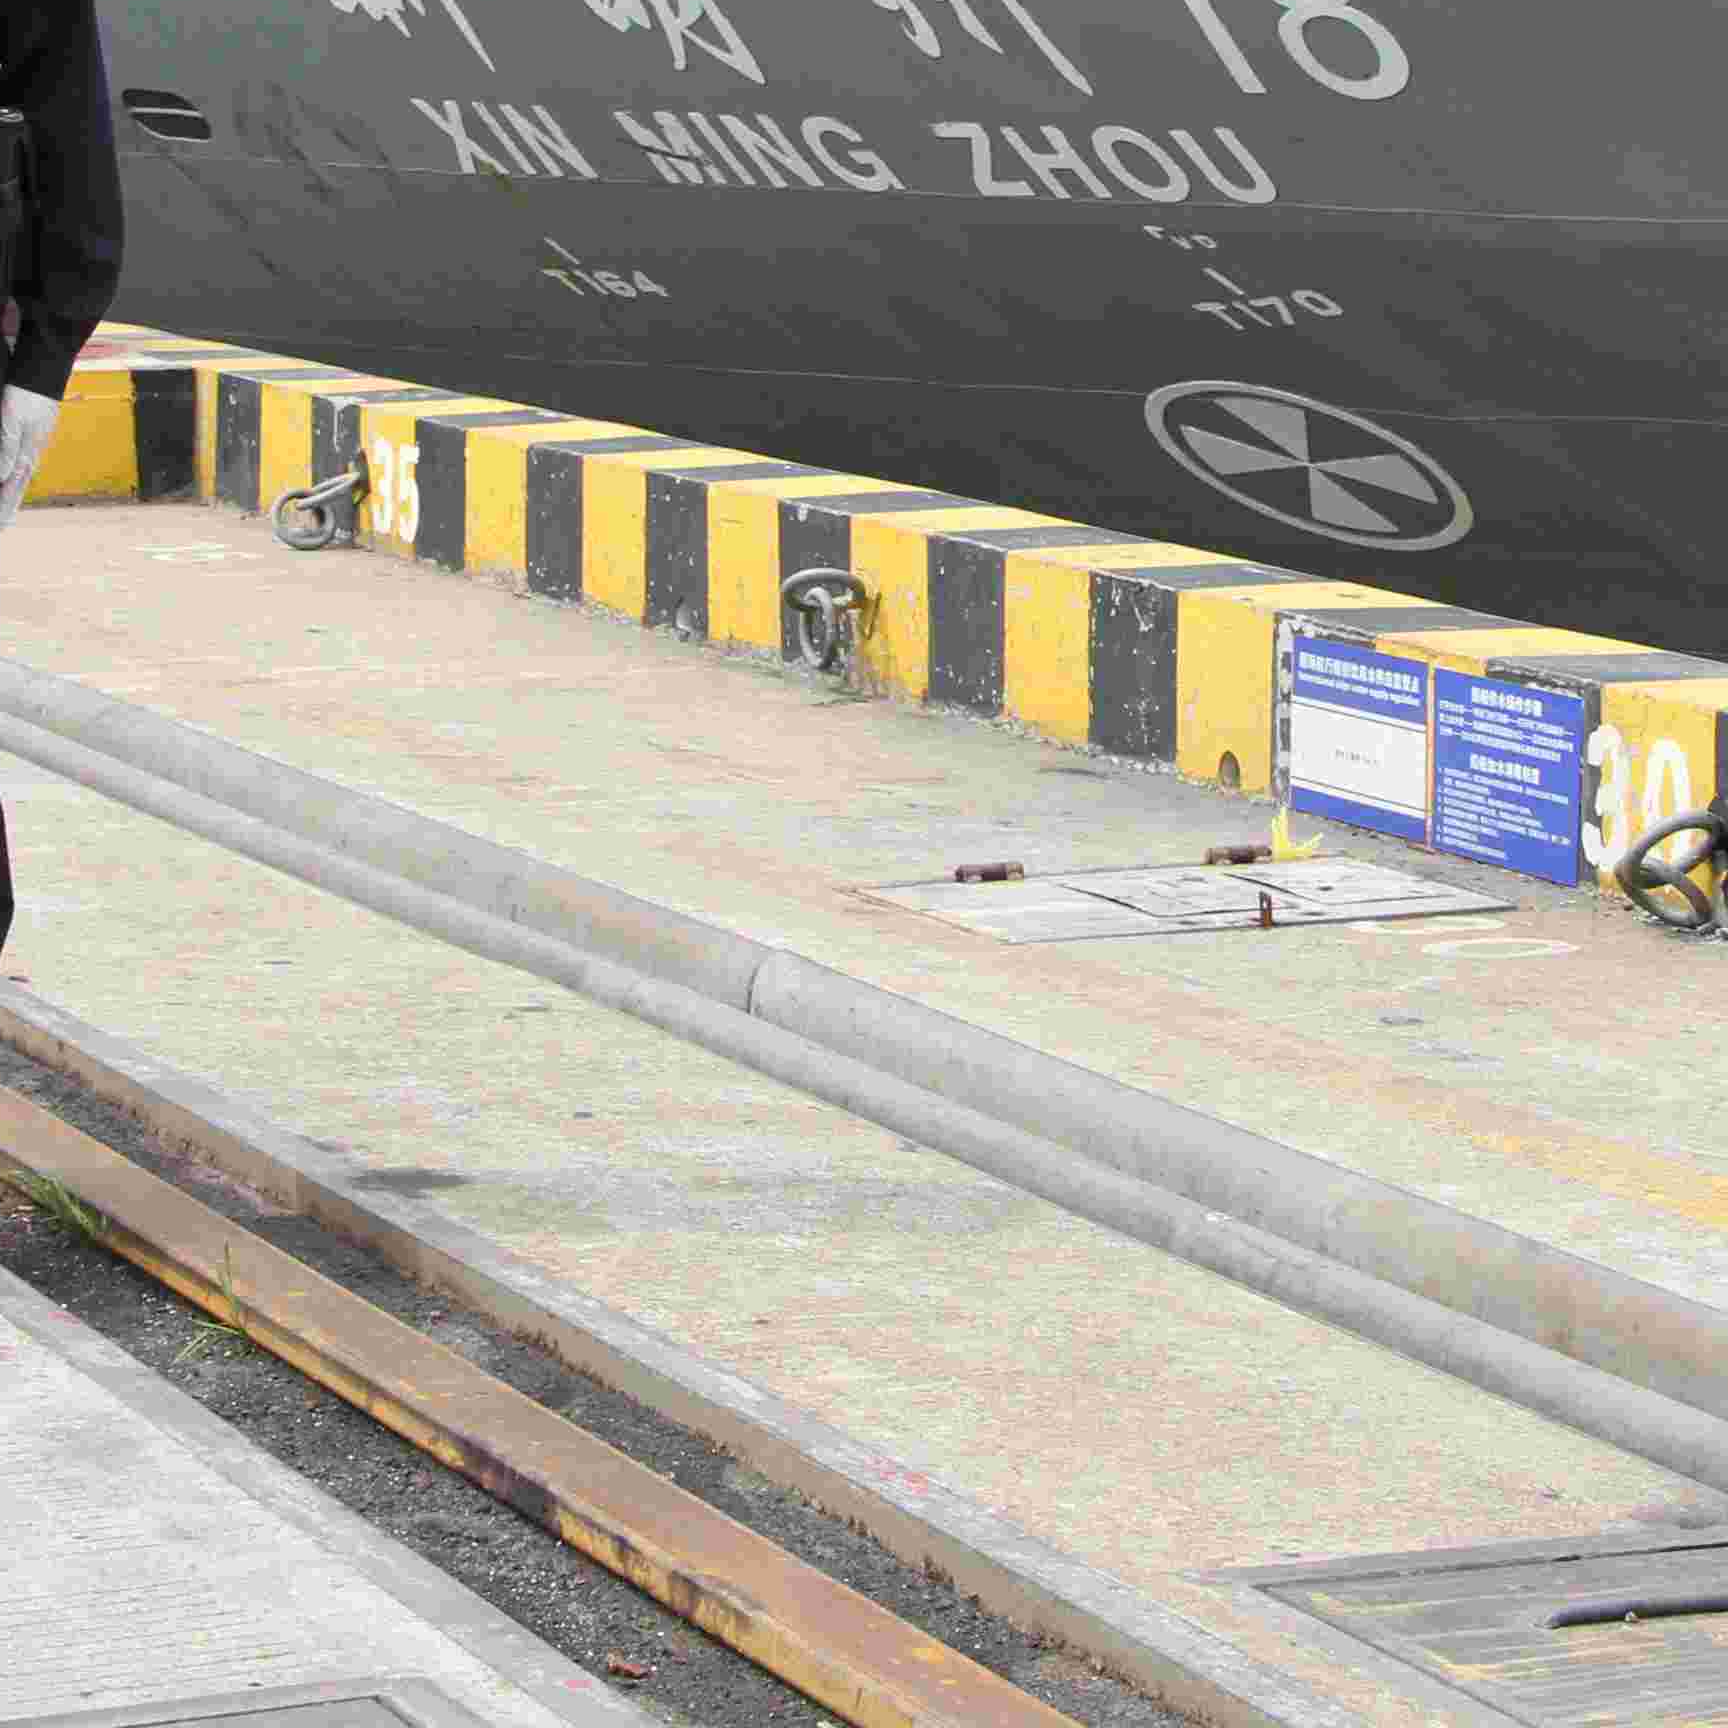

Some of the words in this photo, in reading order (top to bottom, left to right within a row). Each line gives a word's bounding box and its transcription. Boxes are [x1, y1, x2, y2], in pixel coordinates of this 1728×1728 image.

[409, 96, 599, 181] XIN
[612, 110, 907, 193] MING
[927, 122, 1277, 205] ZHOU
